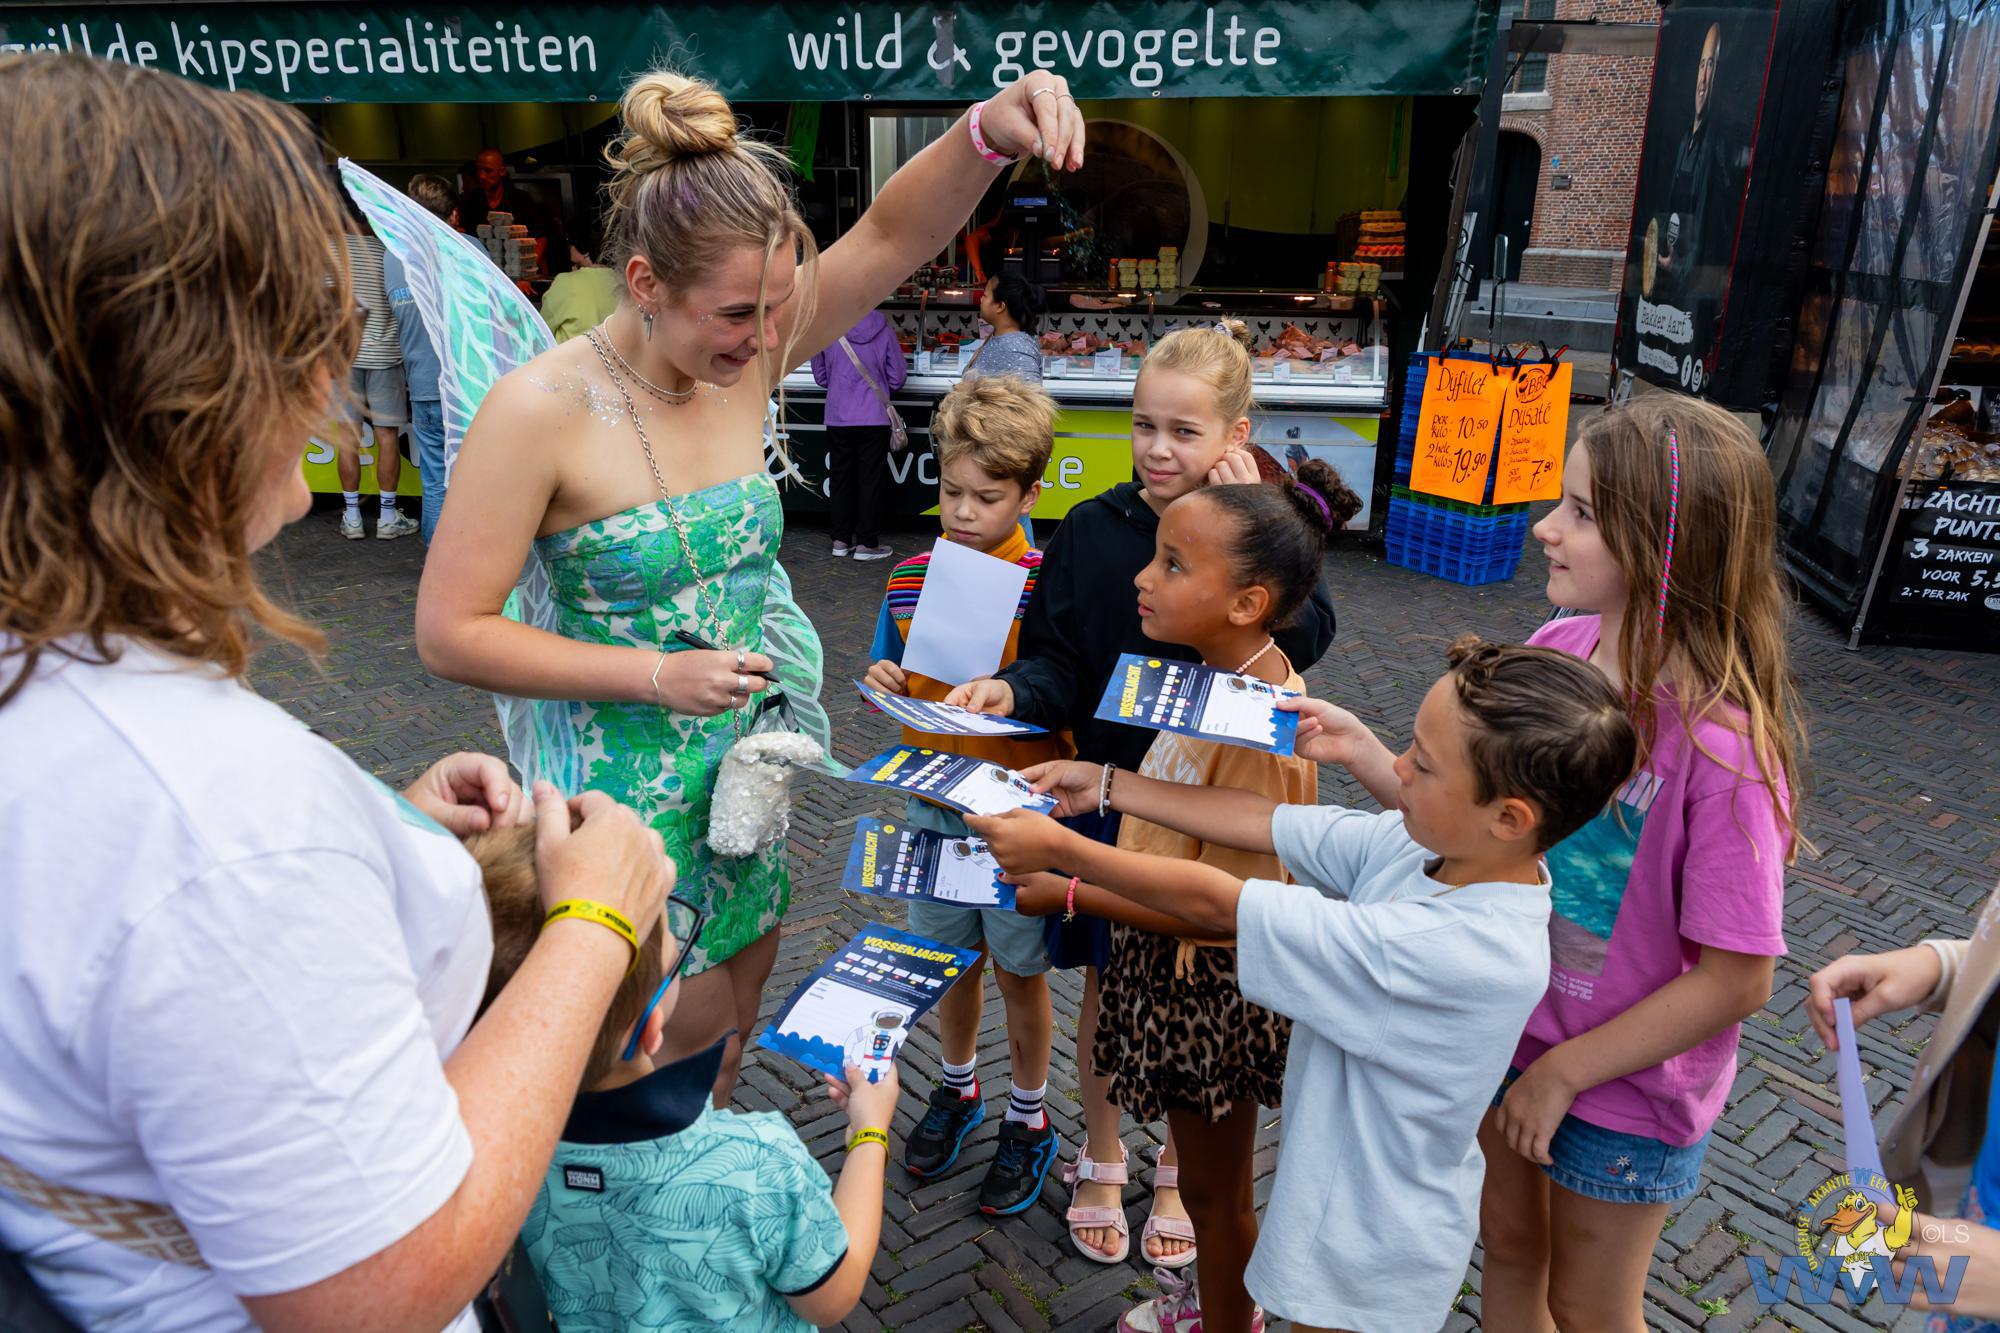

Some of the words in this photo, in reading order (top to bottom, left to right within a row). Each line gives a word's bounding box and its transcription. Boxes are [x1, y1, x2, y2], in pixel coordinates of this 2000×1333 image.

[171, 21, 597, 93] kipspecialiteiten
[787, 12, 901, 71] wild
[992, 8, 1281, 88] gevogelte
[1424, 443, 1435, 458] 2
[1924, 490, 2000, 515] ZACHT
[1910, 538, 1930, 559] 3
[1936, 549, 1994, 565] ZAKKEN
[1921, 568, 1961, 585] VOOR
[1922, 588, 1944, 601] PER
[1946, 590, 1971, 602] ZAK
[861, 831, 879, 888] VOSSENJACHT
[863, 935, 958, 964] VOSSENJACHT
